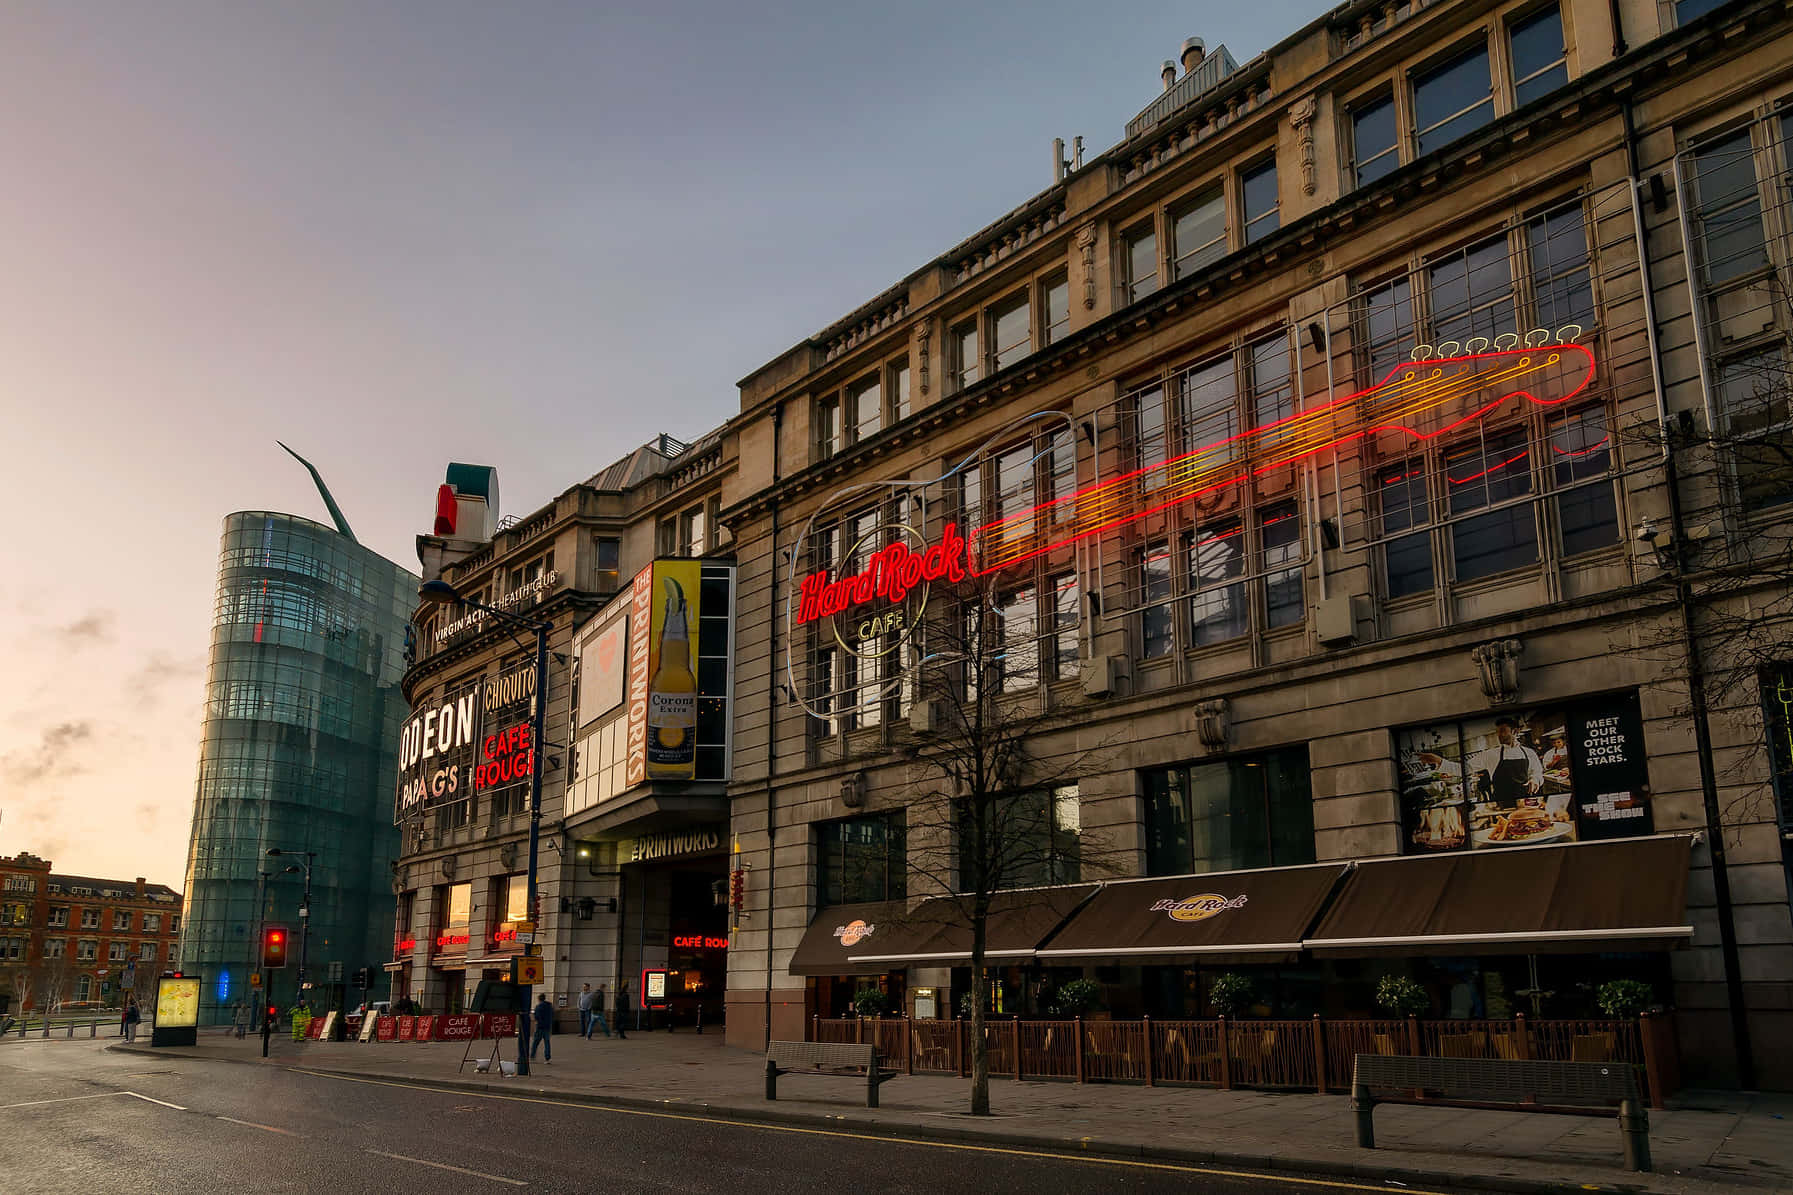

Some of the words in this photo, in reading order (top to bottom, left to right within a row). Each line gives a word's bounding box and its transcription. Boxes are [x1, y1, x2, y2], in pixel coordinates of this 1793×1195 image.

[635, 568, 651, 592] THE
[797, 551, 877, 625] Hard
[876, 522, 966, 603] Rock
[434, 618, 464, 642] VIRGIN
[498, 583, 530, 612] HEALTH
[532, 570, 556, 593] CLUB
[857, 609, 904, 641] CAFE
[485, 666, 536, 712] CHIQUITO
[628, 588, 650, 783] PRINTWORKS
[652, 694, 695, 707] Corona
[660, 706, 688, 714] Extra
[400, 692, 474, 773] ODEON
[1586, 717, 1620, 729] MEET
[1590, 727, 1617, 737] OUR
[1584, 735, 1625, 748] OTHER
[1589, 745, 1623, 757] ROCK
[1586, 754, 1628, 766] STARS.
[402, 775, 428, 810] PAPA
[638, 831, 719, 861] PRINTWORKS
[1149, 899, 1200, 911] Hard
[1200, 894, 1249, 912] Rock
